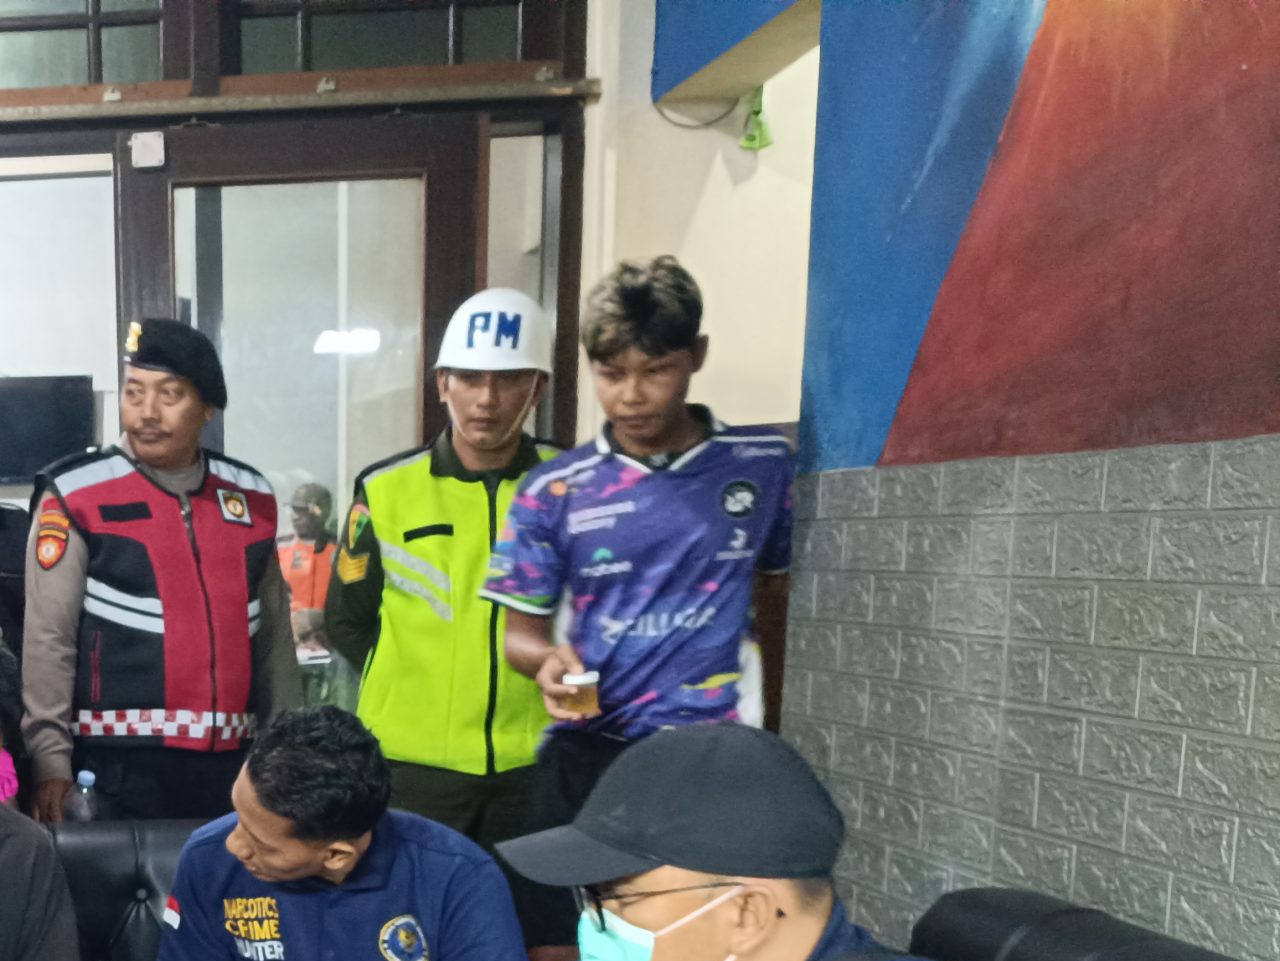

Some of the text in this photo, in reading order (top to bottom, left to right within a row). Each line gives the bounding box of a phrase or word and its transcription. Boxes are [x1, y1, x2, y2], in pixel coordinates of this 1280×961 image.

[467, 311, 522, 350] PM
[223, 897, 279, 918] NARCOTICS
[225, 919, 281, 940] CRIME
